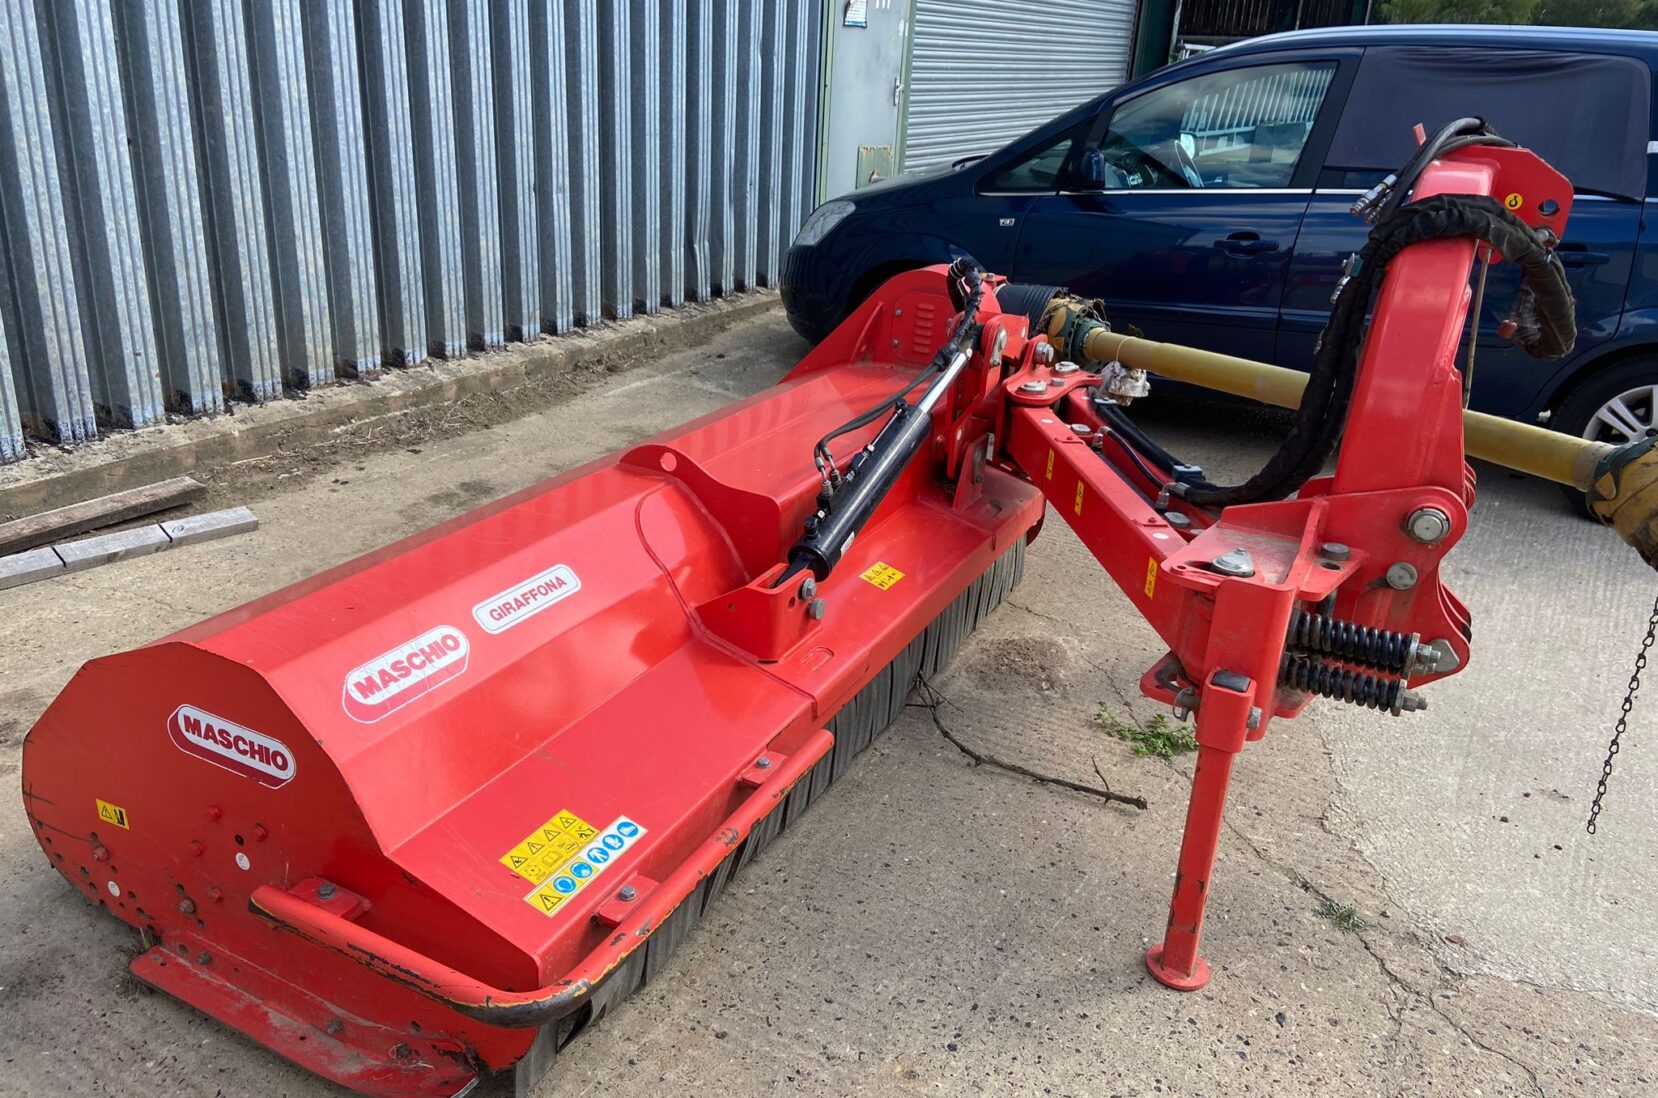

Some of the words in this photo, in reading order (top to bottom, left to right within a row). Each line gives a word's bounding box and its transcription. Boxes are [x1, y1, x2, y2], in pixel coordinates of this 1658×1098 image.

[489, 576, 567, 621] GIRAFFONA
[353, 634, 460, 699] MASCHIO
[183, 714, 288, 771] MASCHIO
